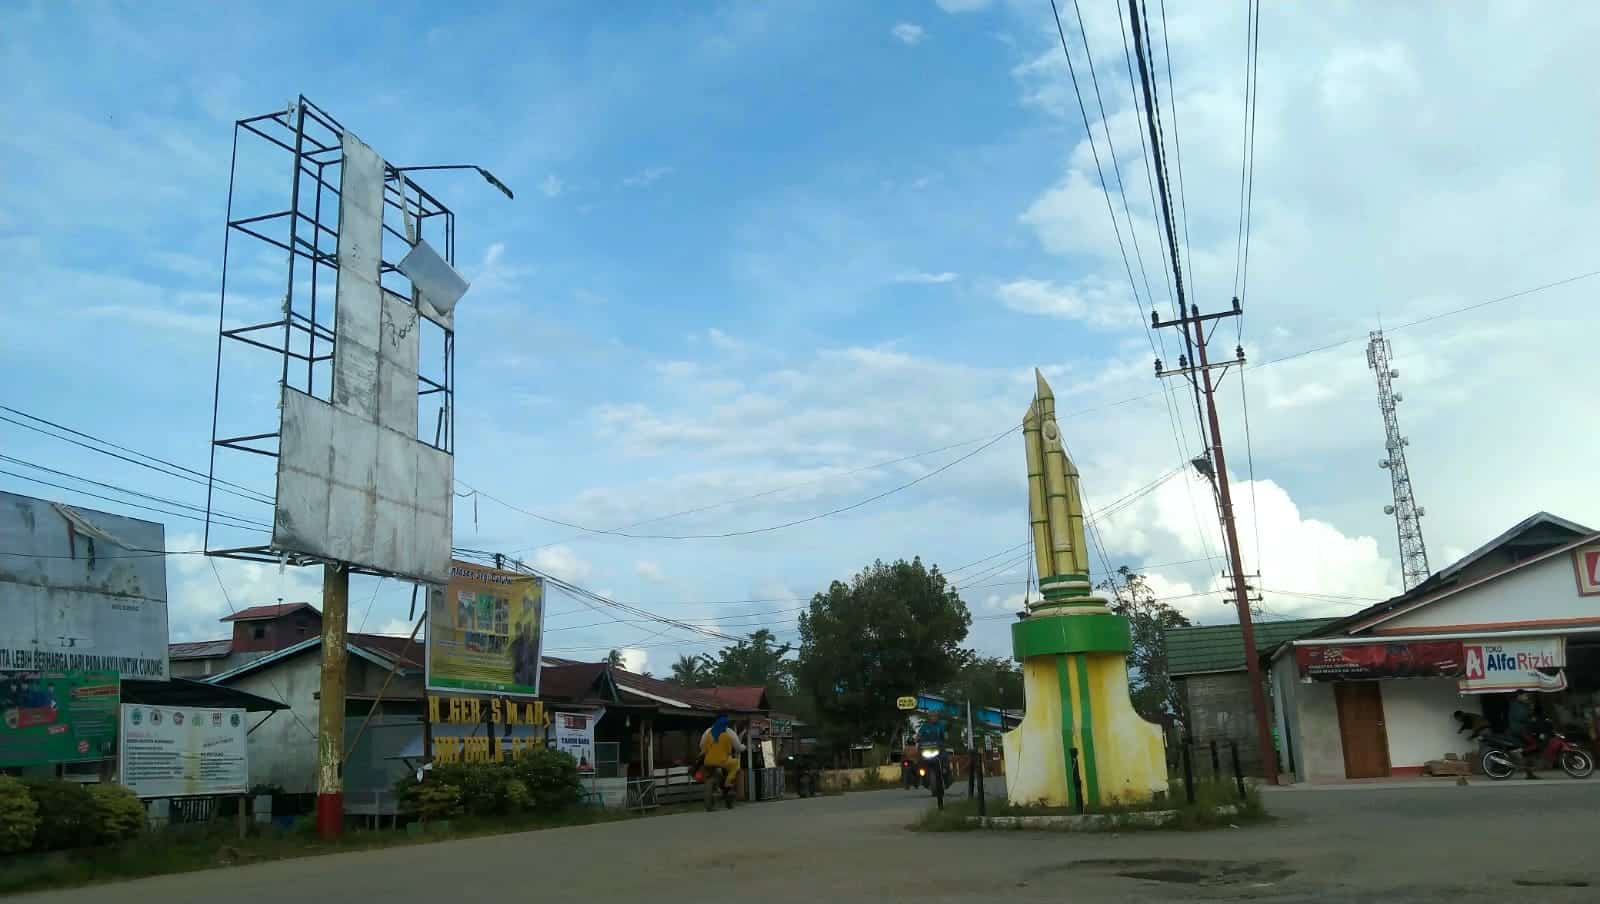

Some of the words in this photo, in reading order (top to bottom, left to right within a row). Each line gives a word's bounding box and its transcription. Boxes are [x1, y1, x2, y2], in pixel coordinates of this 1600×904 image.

[12, 649, 32, 669] LEBIH
[34, 650, 68, 671] BERHARGA
[70, 653, 85, 671] DARI
[120, 656, 138, 674] UNTUK
